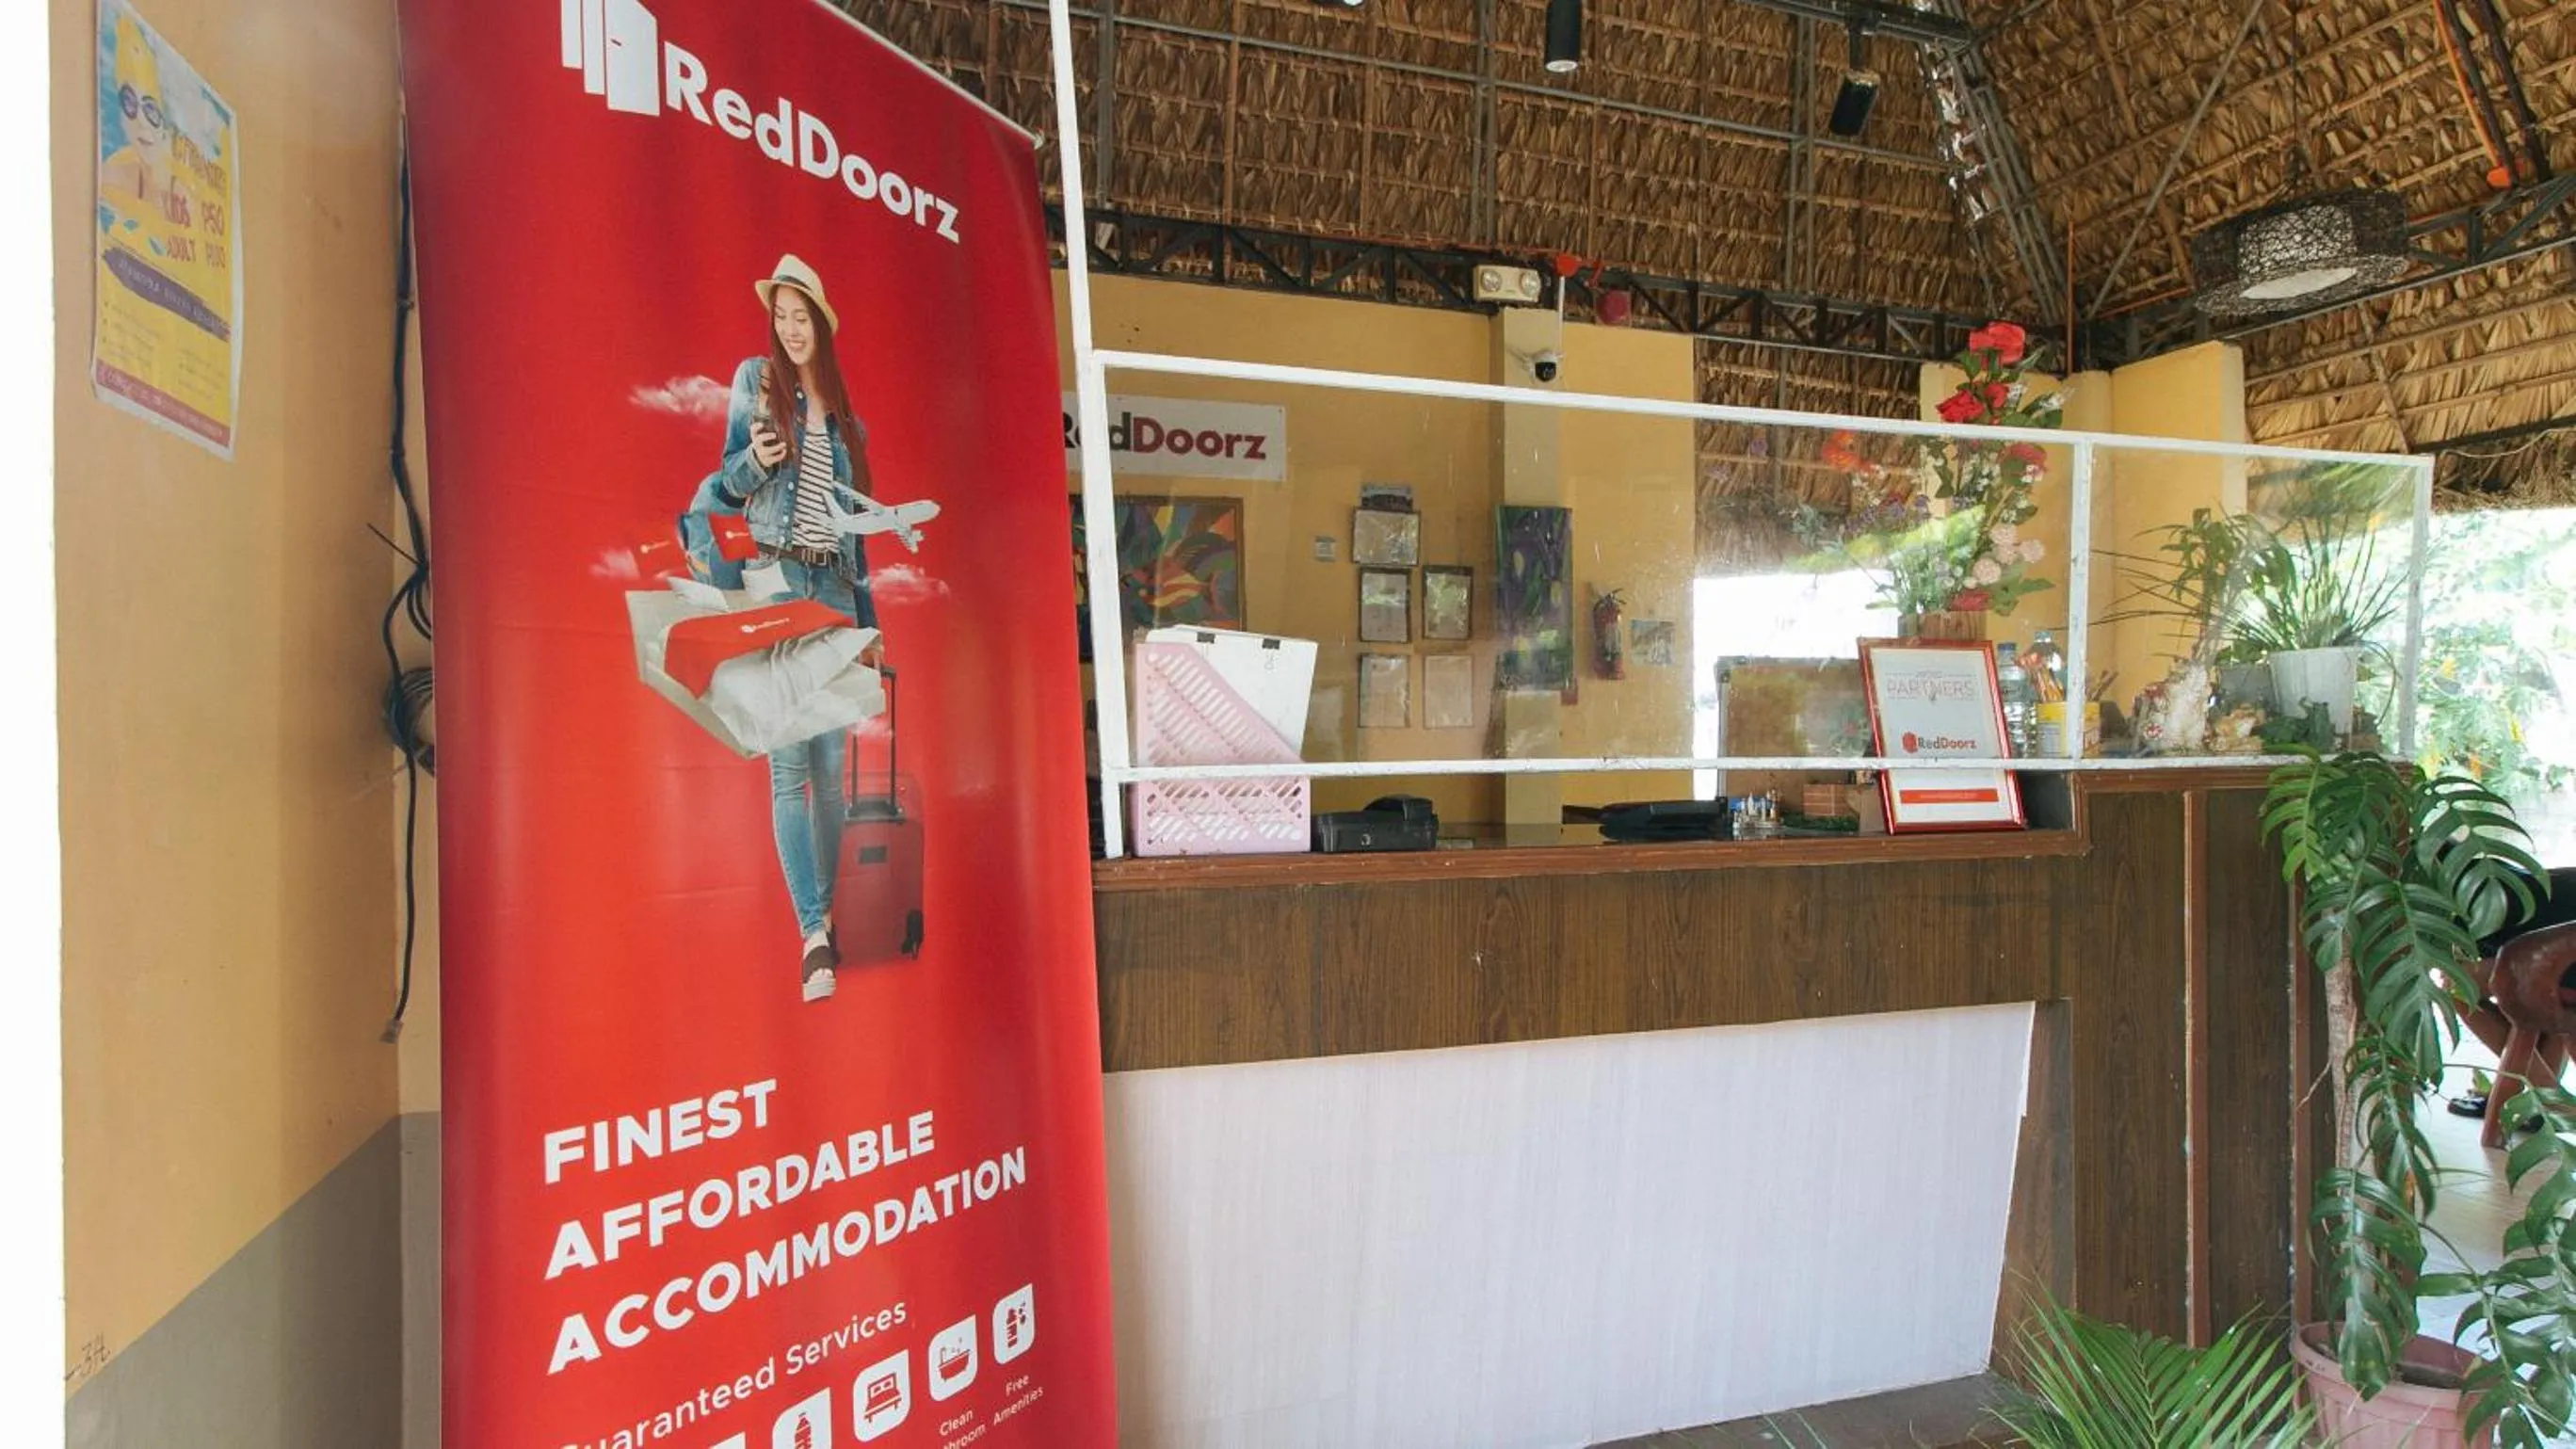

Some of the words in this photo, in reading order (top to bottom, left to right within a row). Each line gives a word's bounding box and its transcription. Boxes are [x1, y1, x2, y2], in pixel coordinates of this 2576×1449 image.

[664, 40, 960, 244] RedDoorz
[1063, 411, 1267, 460] dDoorz
[1886, 679, 1975, 698] PARTNERS
[1918, 736, 1977, 749] RedDoorz
[544, 1079, 777, 1184] FINEST
[544, 1110, 935, 1280] AFFORDABLE
[547, 1147, 1027, 1376] ACCOMMODATION
[560, 1357, 775, 1449] aranteed
[785, 1301, 907, 1376] Services
[1005, 1375, 1029, 1397] Free
[939, 1409, 974, 1437] Clean
[992, 1386, 1044, 1426] Amenities
